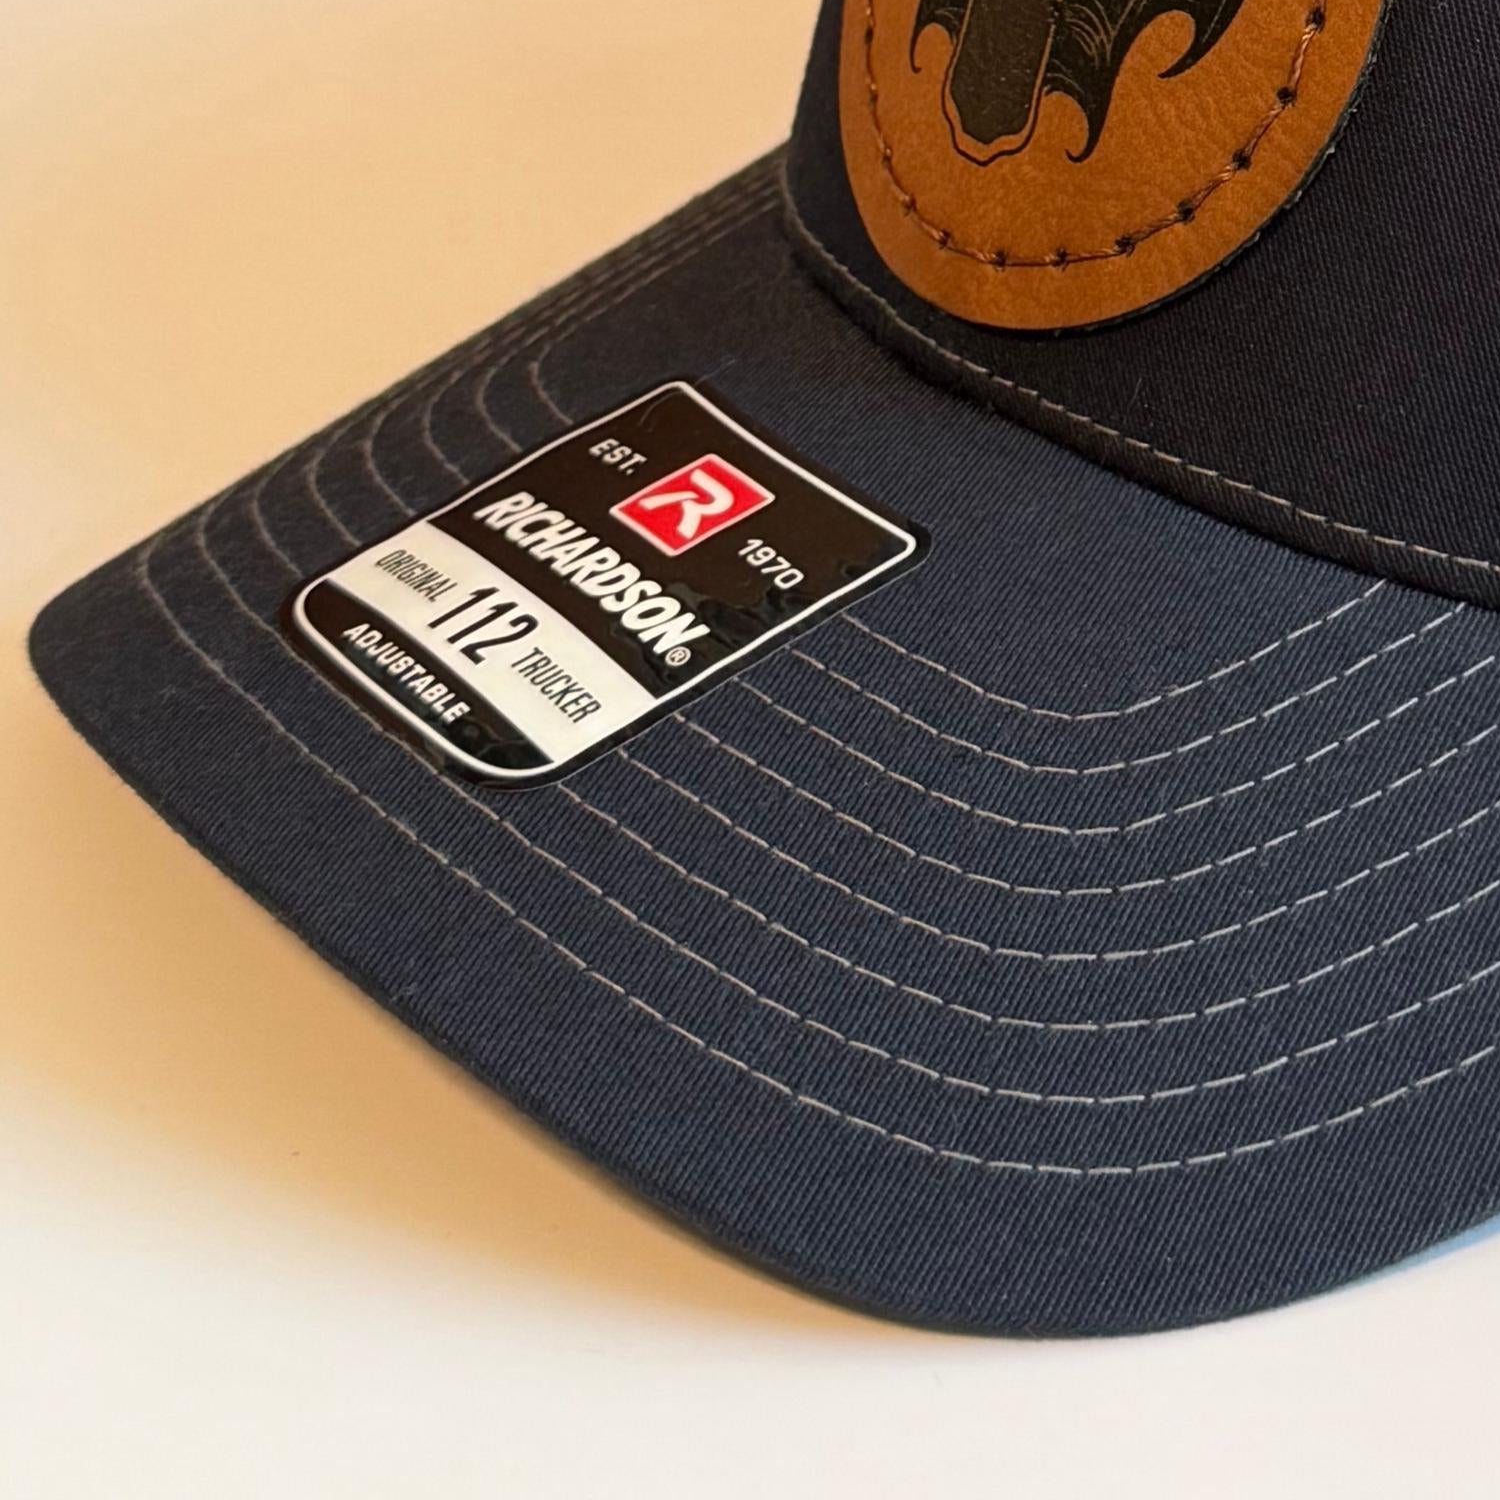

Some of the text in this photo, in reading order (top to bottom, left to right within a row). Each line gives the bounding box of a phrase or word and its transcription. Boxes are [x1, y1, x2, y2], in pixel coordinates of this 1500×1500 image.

[589, 438, 804, 590] EST. 1970
[343, 621, 471, 724] ADJUSTABLE
[374, 548, 603, 726] ORIGINAL 112 TRUCKER
